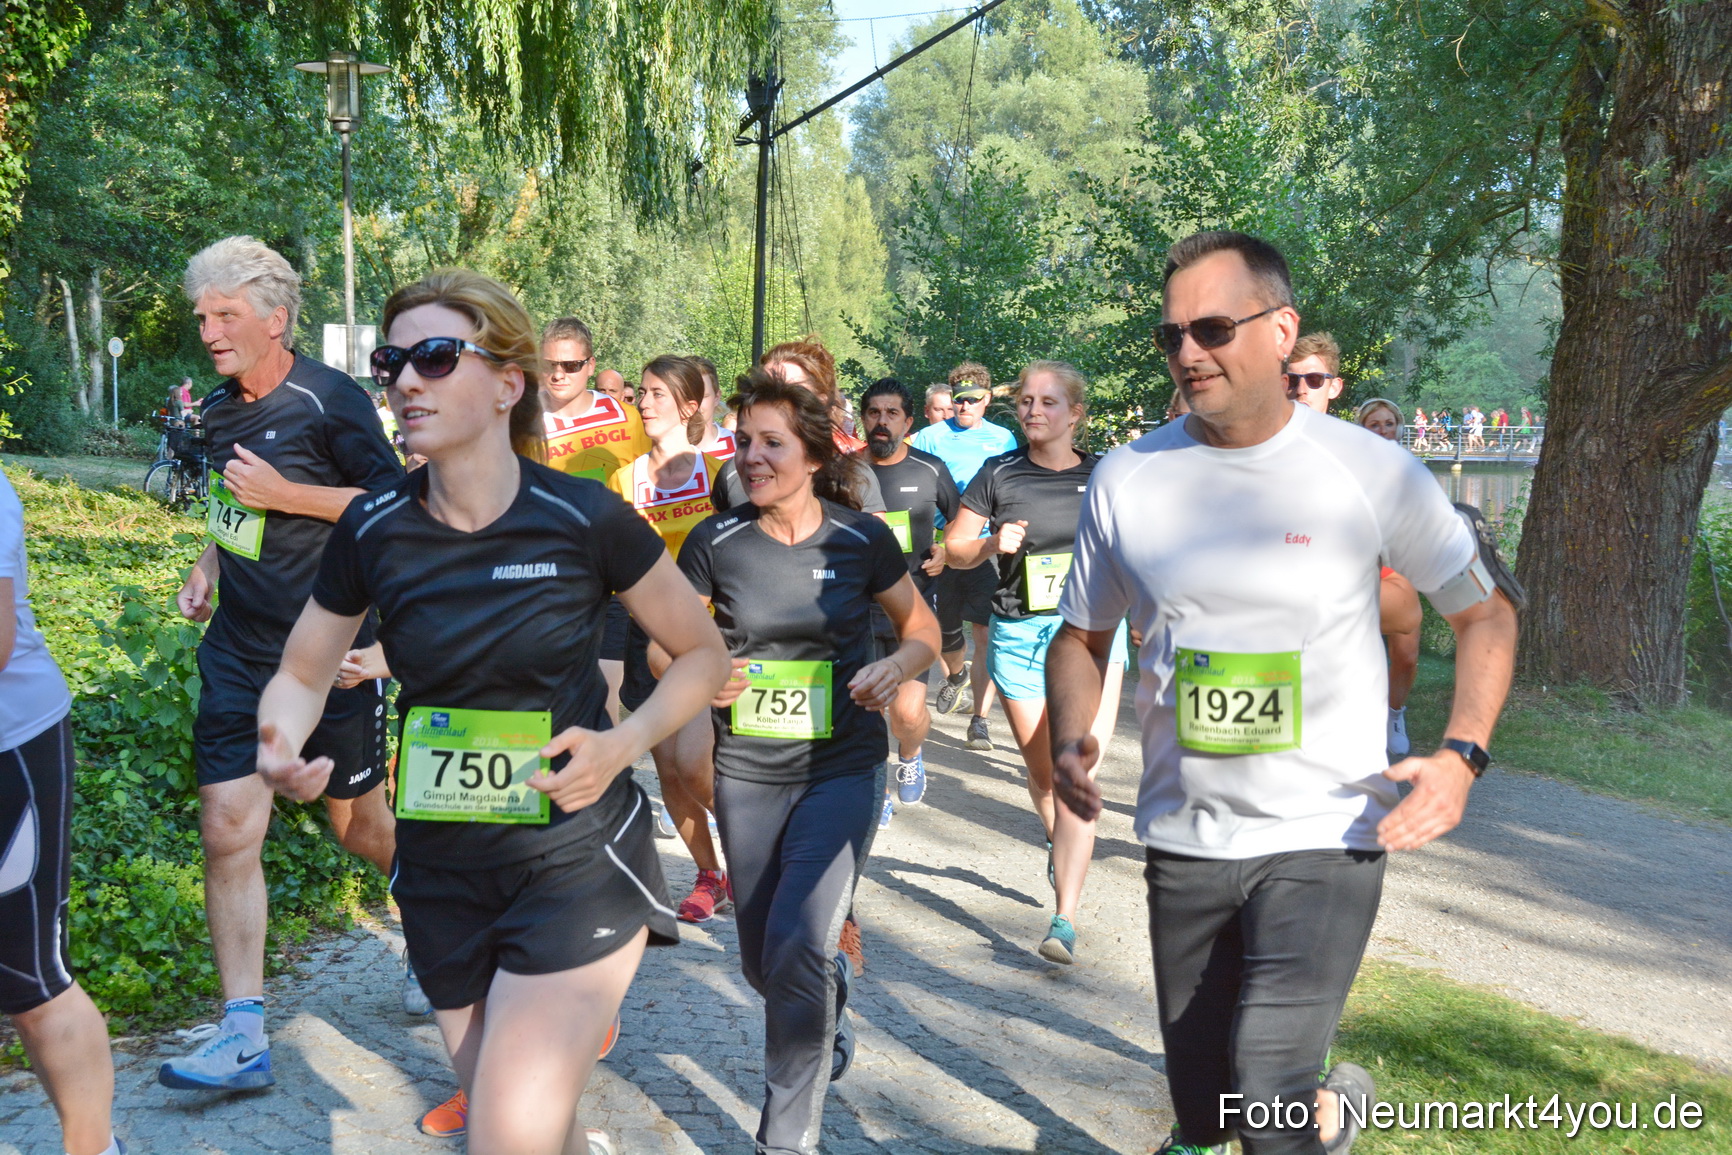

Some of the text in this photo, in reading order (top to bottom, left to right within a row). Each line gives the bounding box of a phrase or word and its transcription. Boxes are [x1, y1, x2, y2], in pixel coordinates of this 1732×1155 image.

[265, 430, 276, 439] EDI
[544, 428, 631, 460] AX BÖGL
[375, 490, 397, 506] JAKO
[216, 499, 248, 534] 747
[641, 502, 713, 523] AX BÖGL
[724, 517, 738, 527] JAKO
[1285, 532, 1312, 547] Eddy
[492, 562, 557, 580] MAGDALENA
[812, 569, 836, 579] TANJA
[751, 688, 807, 715] 752
[1188, 686, 1284, 724] 1924
[756, 716, 780, 724] Kölbel
[1189, 721, 1281, 736] Reitenbach Eduard
[349, 767, 372, 785] JAKO
[431, 750, 513, 790] 750
[423, 790, 521, 804] Gimpl Magdalena
[413, 801, 461, 810] Grundschule
[475, 804, 488, 812] der
